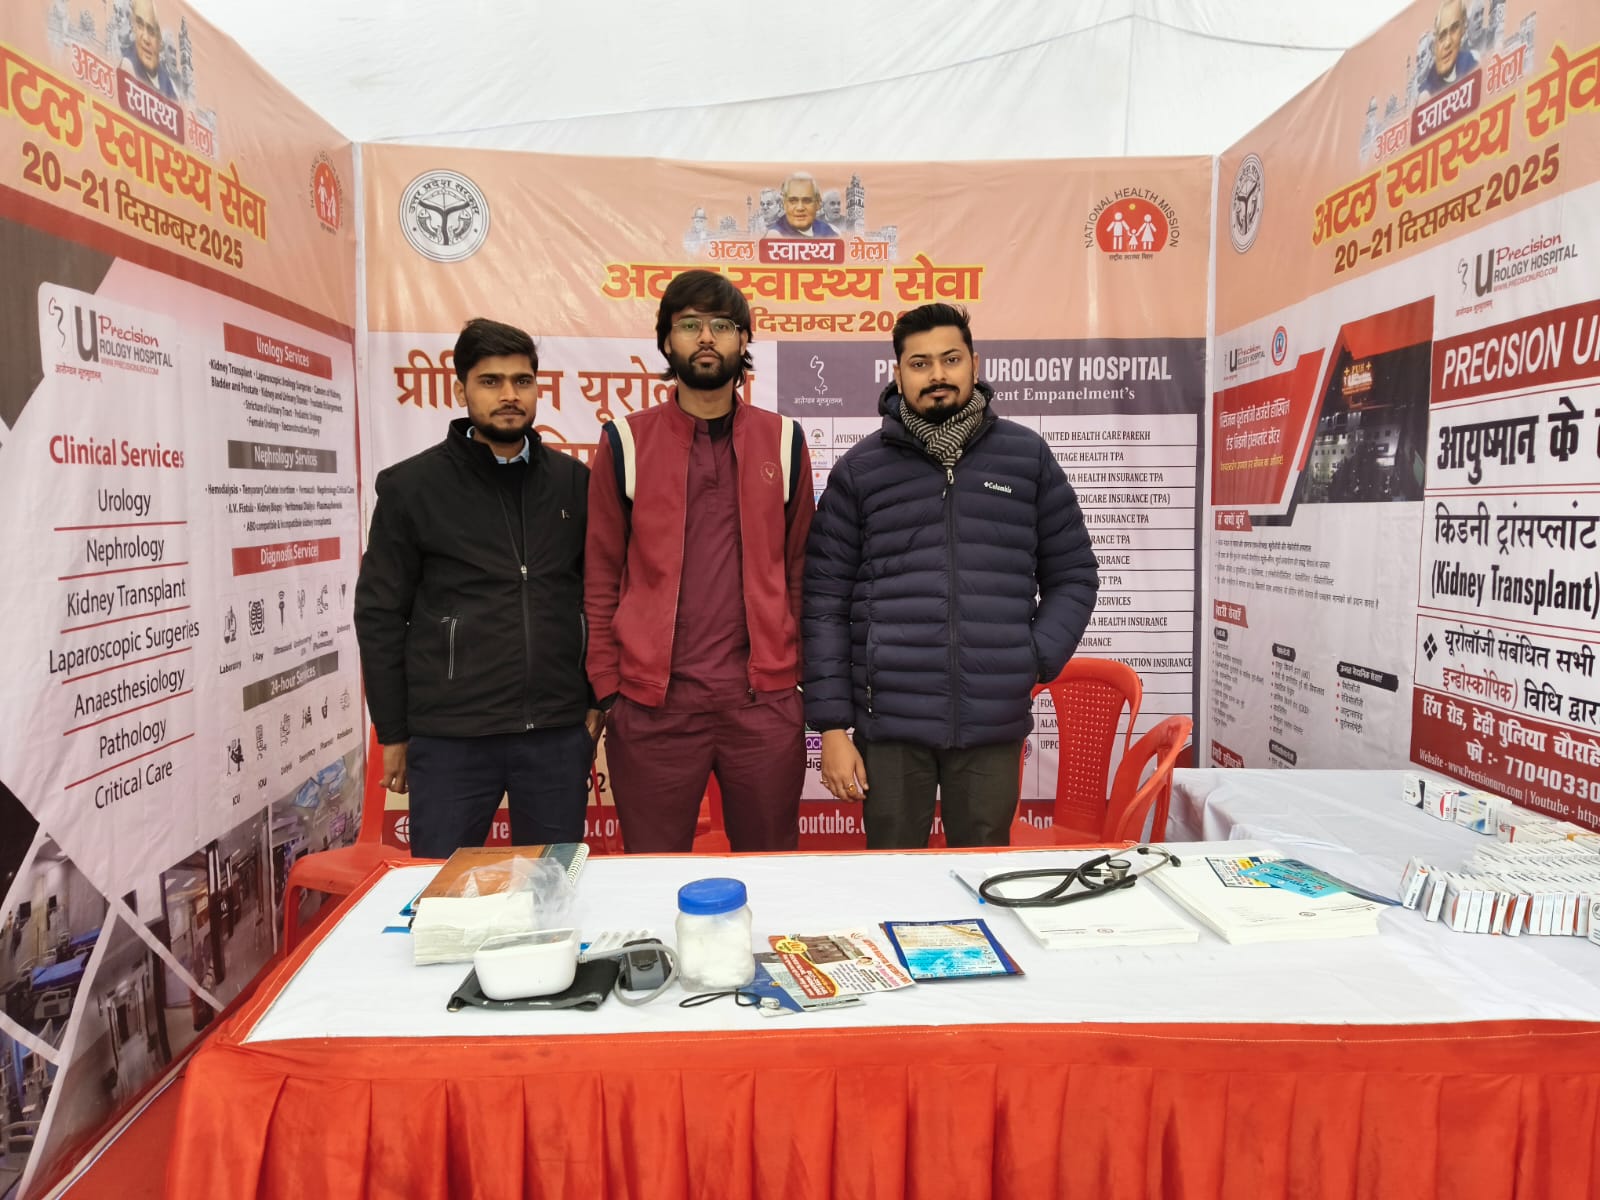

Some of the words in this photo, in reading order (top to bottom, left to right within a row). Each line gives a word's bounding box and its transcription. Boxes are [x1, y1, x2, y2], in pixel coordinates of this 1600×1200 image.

[72, 43, 115, 98] अटल
[126, 78, 178, 137] स्वास्थ्य
[1374, 118, 1410, 162] अटल
[1417, 78, 1475, 136] स्वास्थ्य
[1486, 44, 1527, 95] मेला
[93, 101, 213, 213] स्वास्थ्य
[218, 162, 268, 241] सेवा
[1313, 170, 1382, 246] अटल
[1386, 95, 1515, 207] स्वास्थ्य
[1399, 183, 1484, 248] दिसम्बर
[1485, 143, 1560, 210] 2025
[115, 180, 197, 251] दिसम्बर
[199, 224, 244, 269] 2025
[1083, 196, 1113, 249] NATIONAL
[1113, 187, 1160, 204] HEALTH
[1158, 198, 1180, 248] MISSION
[707, 240, 755, 261] अटल
[767, 241, 836, 262] स्वास्थ्य
[849, 236, 890, 261] मेला
[1496, 233, 1562, 266] Precision
[1531, 244, 1578, 270] HOSPITAL
[602, 264, 722, 300] अट
[728, 264, 884, 302] स्वास्थ्य
[894, 253, 984, 301] सेवा
[98, 314, 159, 347] Precision
[750, 306, 856, 333] दिसम्बर
[134, 345, 173, 367] HOSPITAL
[256, 336, 284, 363] Urology
[285, 345, 310, 367] Services
[1442, 321, 1566, 390] PRECISION
[985, 358, 1074, 382] UROLOGY
[1078, 356, 1173, 381] HOSPITAL
[49, 434, 117, 465] Clinical
[121, 441, 185, 468] Services
[1042, 432, 1070, 442] UNITED
[1071, 432, 1101, 441] HEALTH
[1102, 431, 1122, 441] CARE
[1122, 431, 1151, 441] PAREKH
[1437, 414, 1540, 485] आयुष्मान
[1547, 396, 1585, 462] के
[254, 445, 294, 469] Nephrology
[295, 450, 318, 466] Services
[1079, 452, 1109, 462] HEALTH
[1109, 451, 1124, 462] TPA
[1077, 473, 1107, 483] HEALTH
[1107, 473, 1148, 483] INSURANCE
[1149, 472, 1164, 483] TPA
[98, 488, 151, 516] Urology
[1076, 494, 1108, 504] EDICARE
[1108, 494, 1149, 504] INSURANCE
[1150, 493, 1171, 506] (TPA)
[1093, 514, 1136, 524] INSURANCE
[1136, 514, 1150, 524] TPA
[1434, 501, 1491, 547] किडनी
[1497, 500, 1600, 555] ट्रांसप्लांट
[87, 535, 164, 566] Nephrology
[1116, 535, 1131, 545] TPA
[67, 589, 114, 617] Kidney
[117, 578, 186, 607] Transplant
[1109, 576, 1122, 585] TPA
[1431, 559, 1486, 608] (Kidney
[1491, 563, 1600, 620] Transplant)
[1097, 596, 1132, 606] SERVICES
[1097, 617, 1127, 627] HEALTH
[1127, 617, 1168, 627] INSURANCE
[49, 631, 142, 675] Laparoscopic
[146, 620, 200, 649] Surgeries
[1152, 658, 1193, 668] INSURANCE
[1444, 624, 1495, 658] यूरोलॉजी
[1498, 632, 1551, 669] संबंधित
[1556, 643, 1596, 678] सभी
[74, 669, 185, 718] Anaesthesiology
[1523, 677, 1563, 717] विधि
[1568, 696, 1600, 725] द्वार
[99, 719, 167, 759] Pathology
[1422, 693, 1443, 720] रिंग
[1446, 700, 1468, 731] रोड,
[1498, 718, 1548, 752] पुलिया
[95, 768, 142, 809] Critical
[145, 761, 173, 785] Care
[1419, 748, 1445, 769] Website
[1448, 761, 1523, 800] www.Precisionuro.com
[1530, 790, 1570, 817] Youtube
